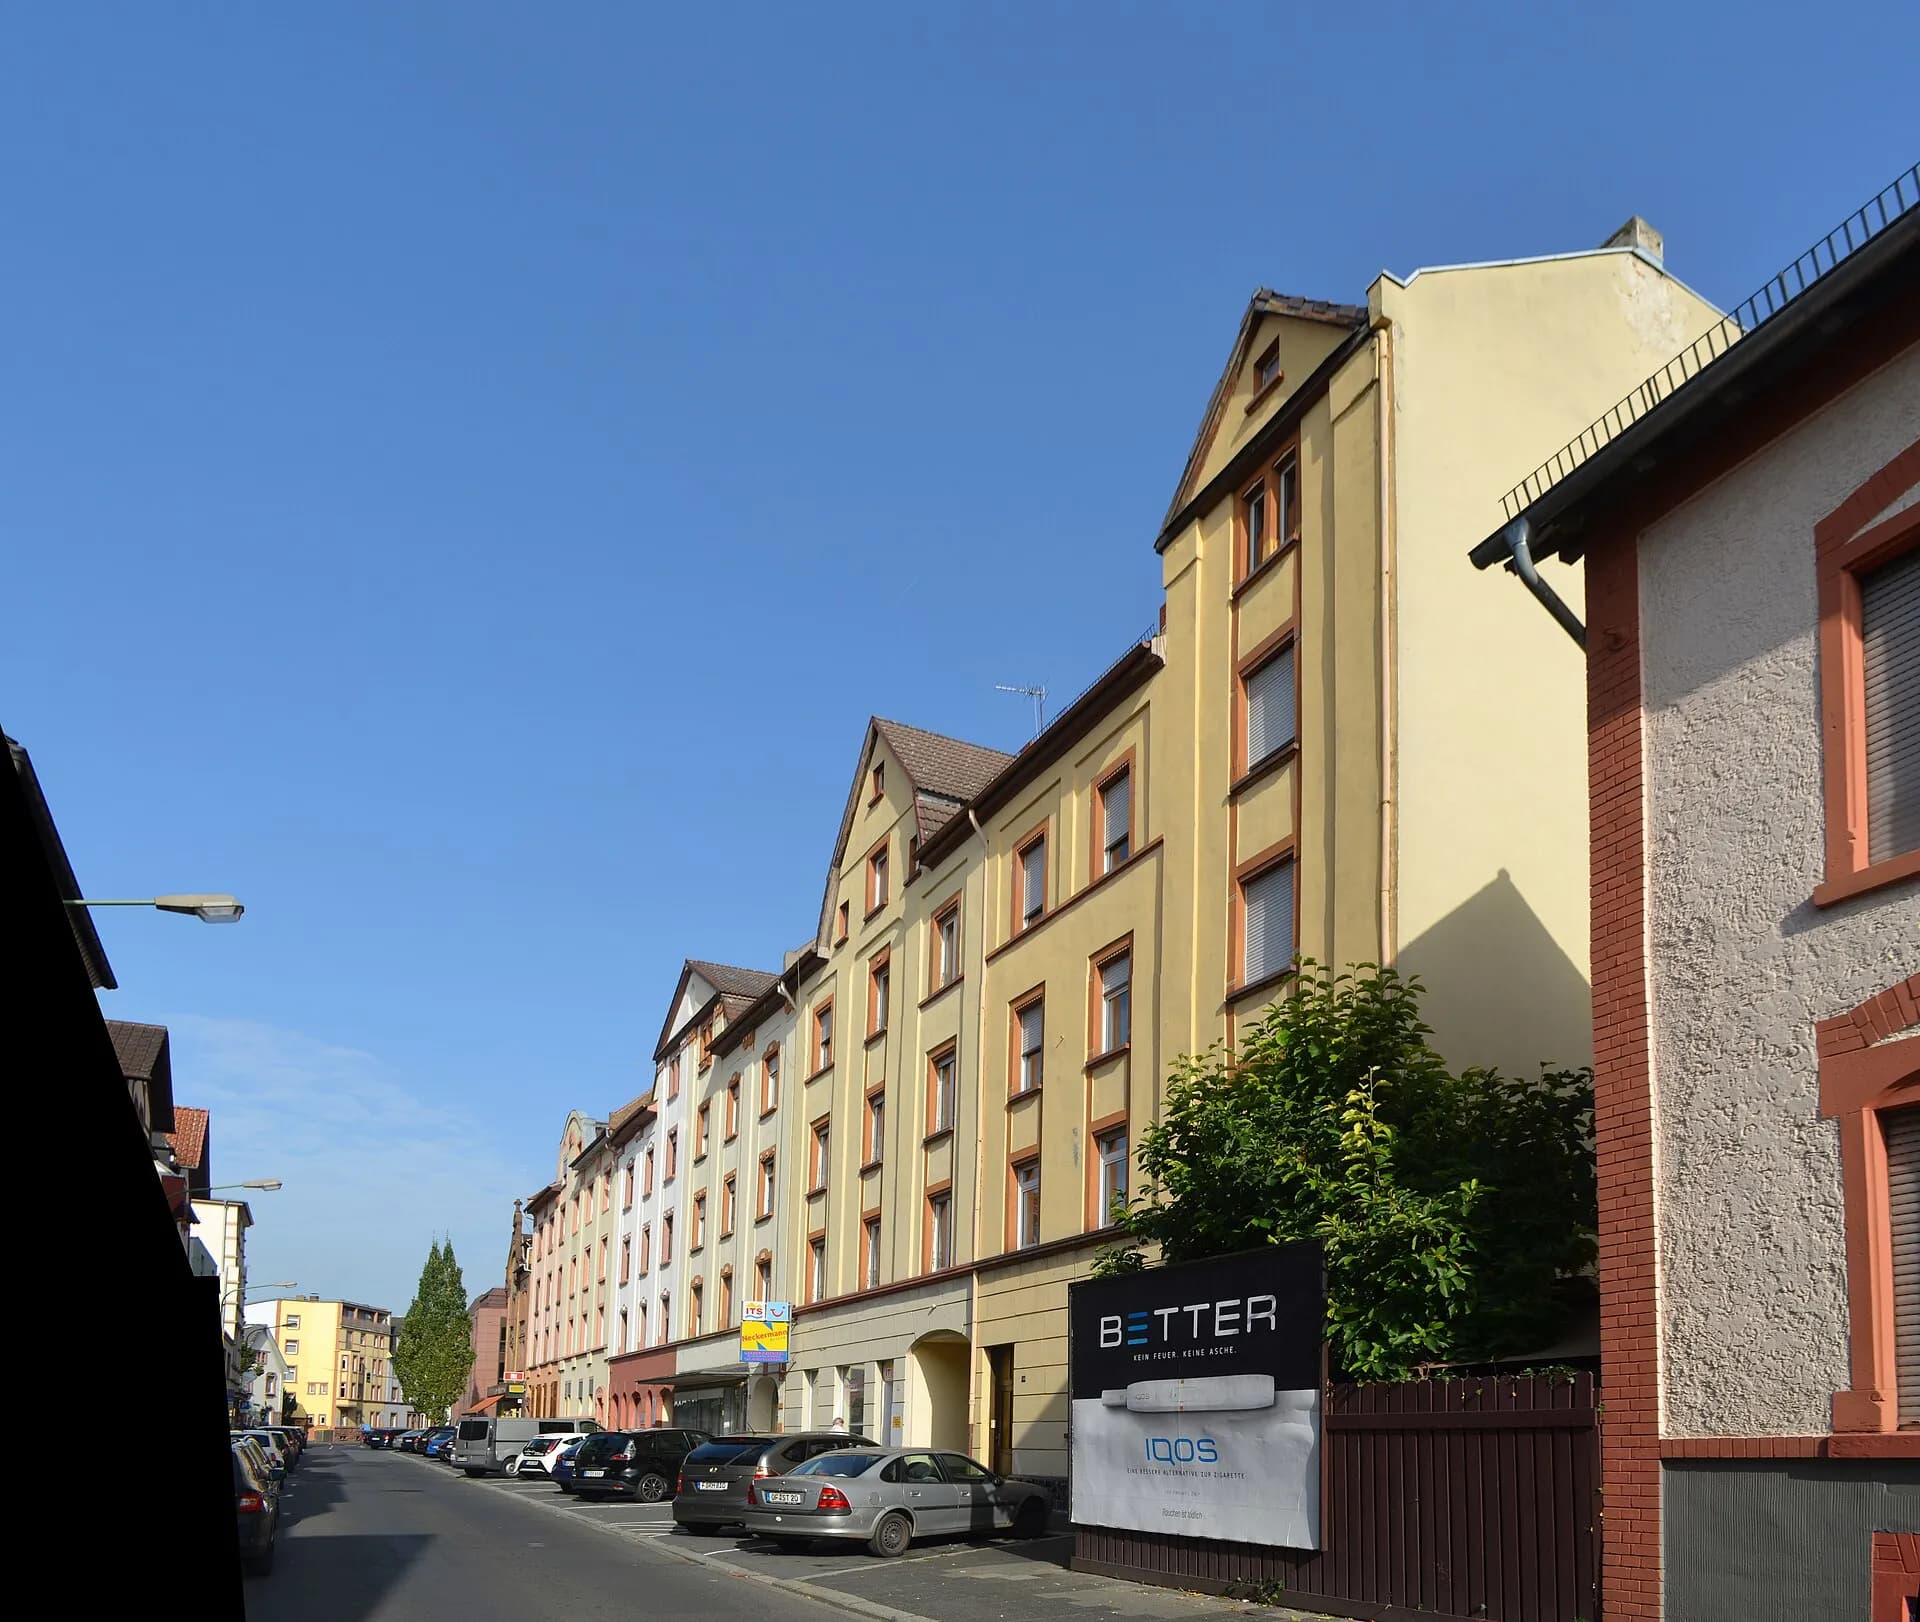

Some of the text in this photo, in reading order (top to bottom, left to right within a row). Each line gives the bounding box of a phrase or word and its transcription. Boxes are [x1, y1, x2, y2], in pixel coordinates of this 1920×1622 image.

[745, 1307, 763, 1315] ITS
[1099, 1294, 1277, 1348] BETTER
[1182, 1348, 1205, 1357] KEINE
[1209, 1346, 1237, 1355] ASCHE.
[1145, 1438, 1218, 1466] IQOS
[1163, 1469, 1197, 1477] ALTERNATIVE
